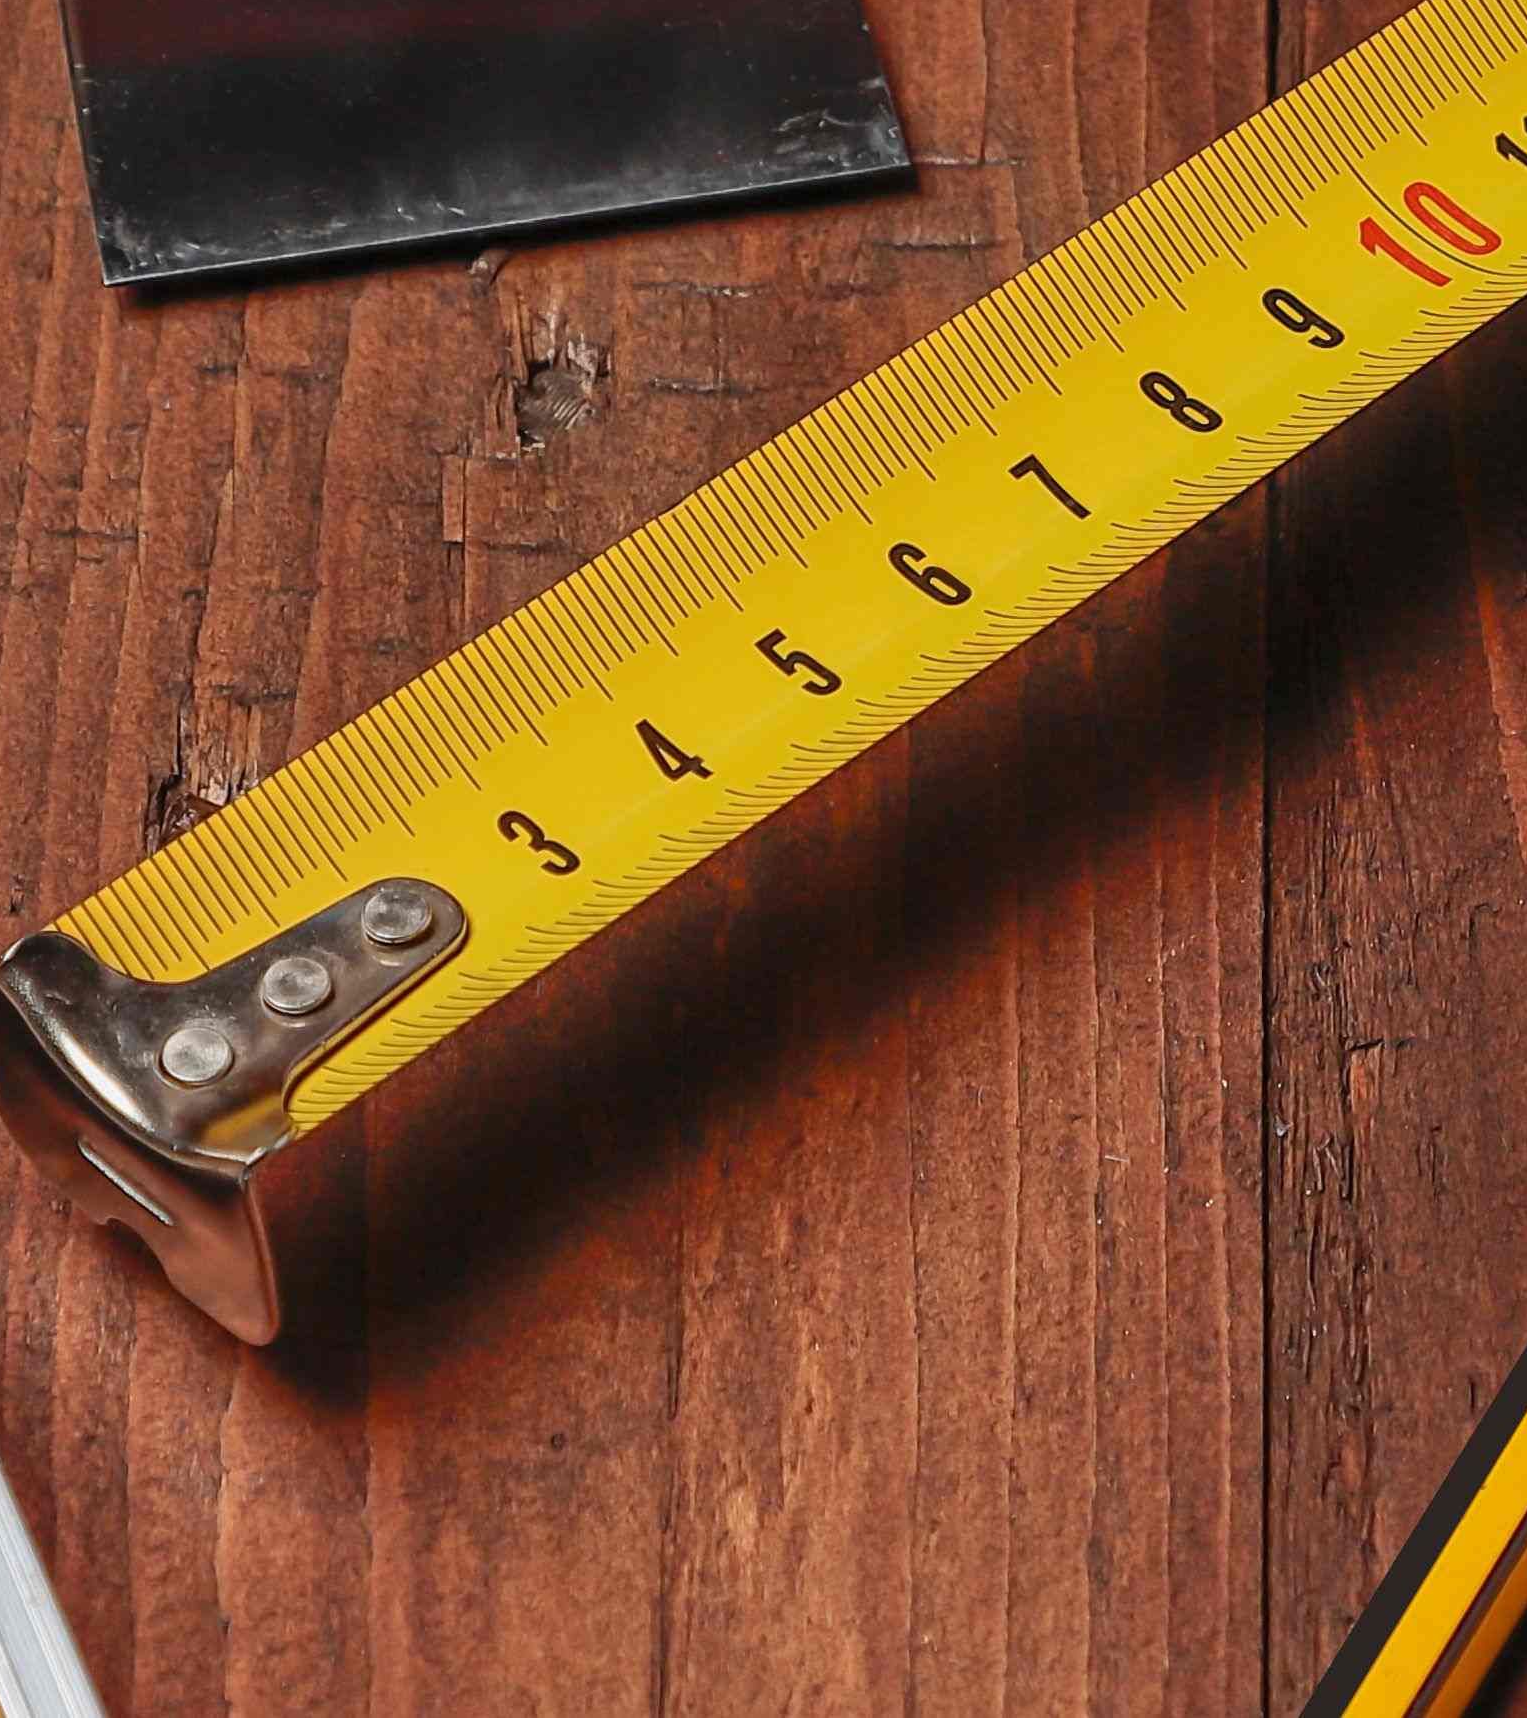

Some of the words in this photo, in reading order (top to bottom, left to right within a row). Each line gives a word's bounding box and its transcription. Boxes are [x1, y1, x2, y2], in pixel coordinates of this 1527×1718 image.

[497, 810, 581, 876] 3
[635, 719, 714, 781] 4
[754, 628, 842, 696] 5
[888, 542, 972, 606] 6
[1008, 453, 1092, 520] 7
[1139, 371, 1223, 433] 8
[1262, 288, 1345, 349] 9
[1359, 181, 1502, 288] 10
